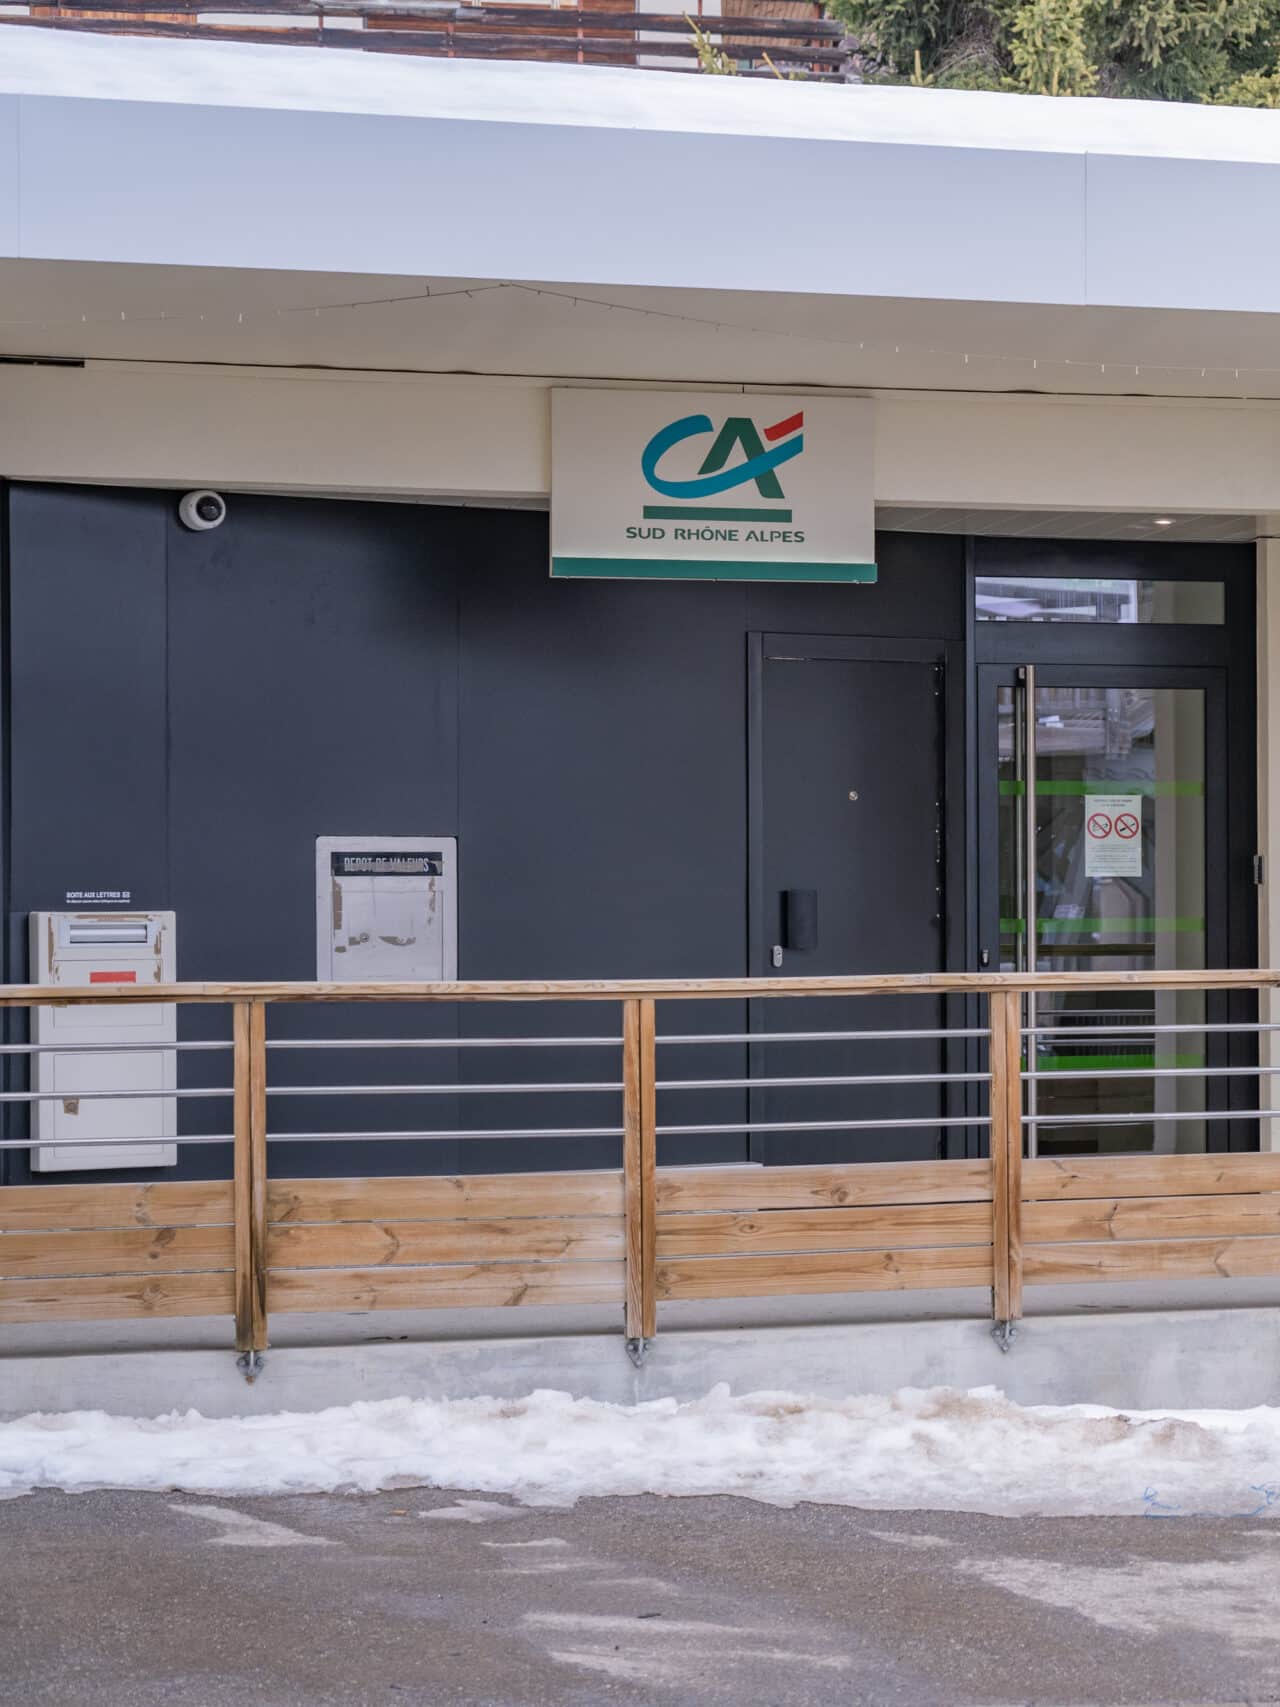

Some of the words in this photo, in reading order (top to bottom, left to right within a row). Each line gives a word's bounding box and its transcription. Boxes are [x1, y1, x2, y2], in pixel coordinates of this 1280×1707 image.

[625, 526, 665, 540] SUD
[673, 526, 739, 542] RHÔNE
[745, 530, 805, 544] ALPES
